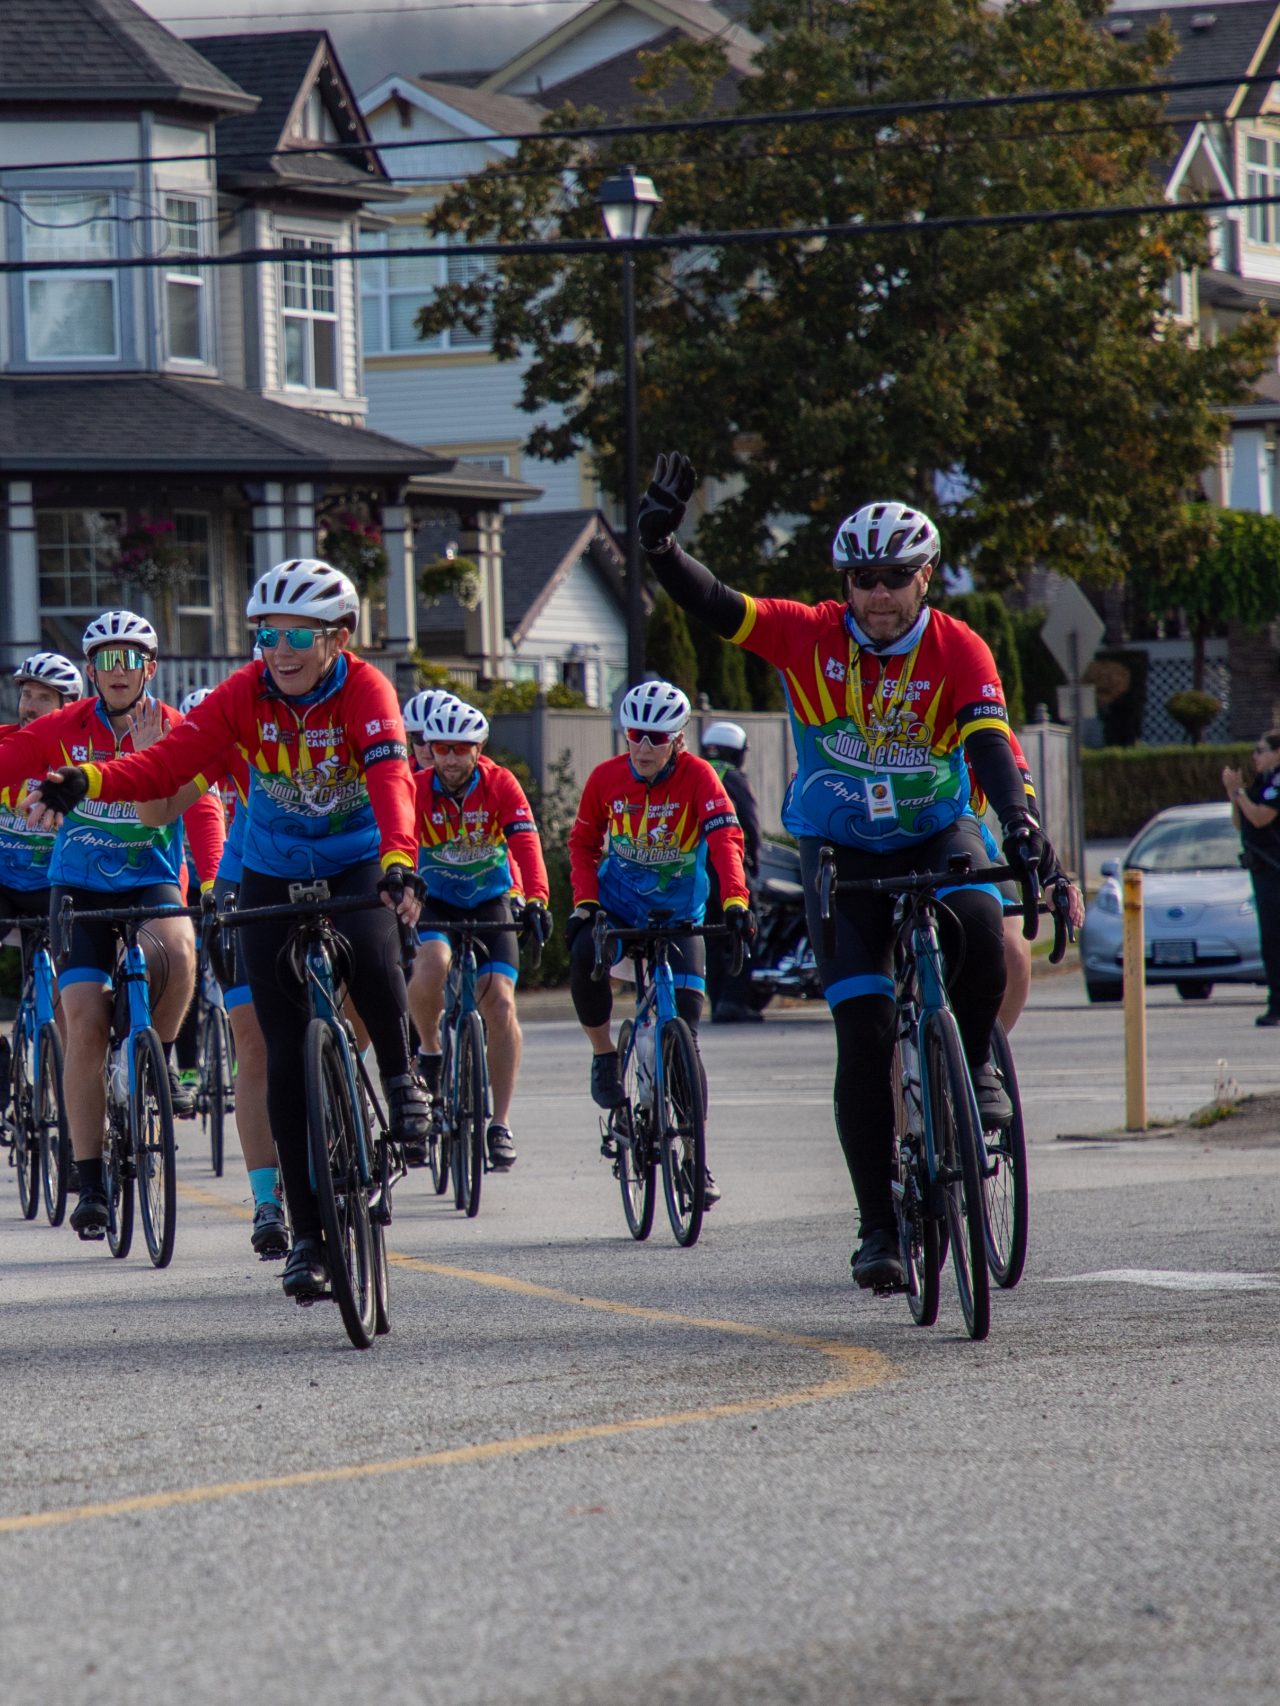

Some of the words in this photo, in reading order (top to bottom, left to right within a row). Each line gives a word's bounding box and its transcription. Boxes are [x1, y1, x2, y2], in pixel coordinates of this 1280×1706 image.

[883, 679, 914, 691] COS
[973, 705, 1004, 717] #386
[305, 728, 330, 739] COPS
[834, 729, 867, 760] Tour
[887, 741, 931, 767] Coast
[84, 797, 108, 816] Tour
[73, 832, 156, 849] Applewood
